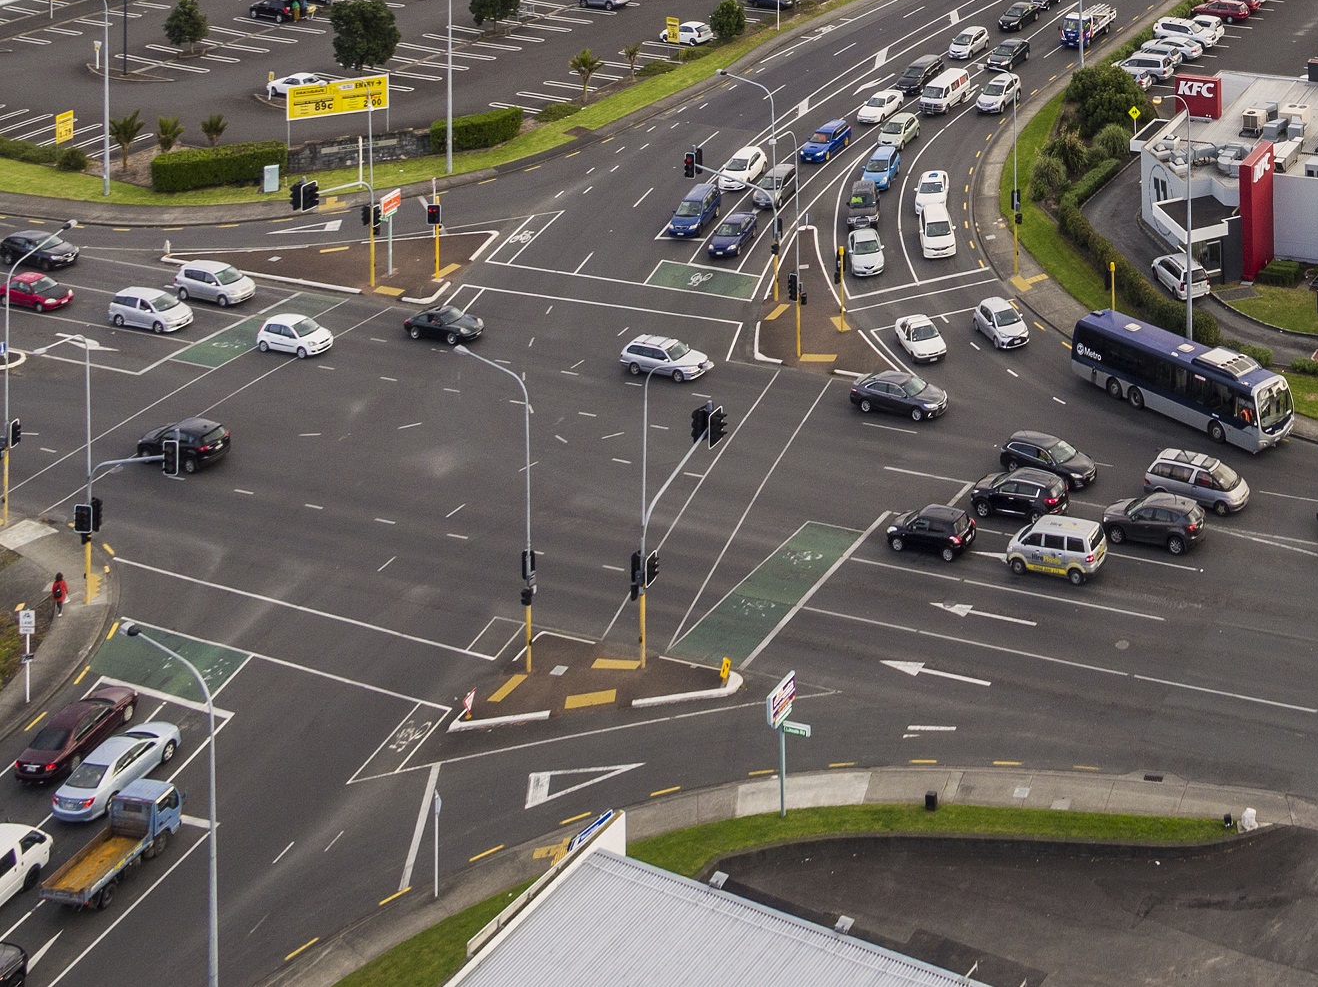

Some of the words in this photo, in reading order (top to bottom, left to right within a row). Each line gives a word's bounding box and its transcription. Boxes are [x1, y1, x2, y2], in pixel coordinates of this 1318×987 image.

[355, 80, 375, 89] ENTRY
[1177, 80, 1215, 98] KFC
[314, 101, 334, 111] 89c
[1253, 152, 1271, 183] KFC
[1084, 346, 1102, 361] Metro
